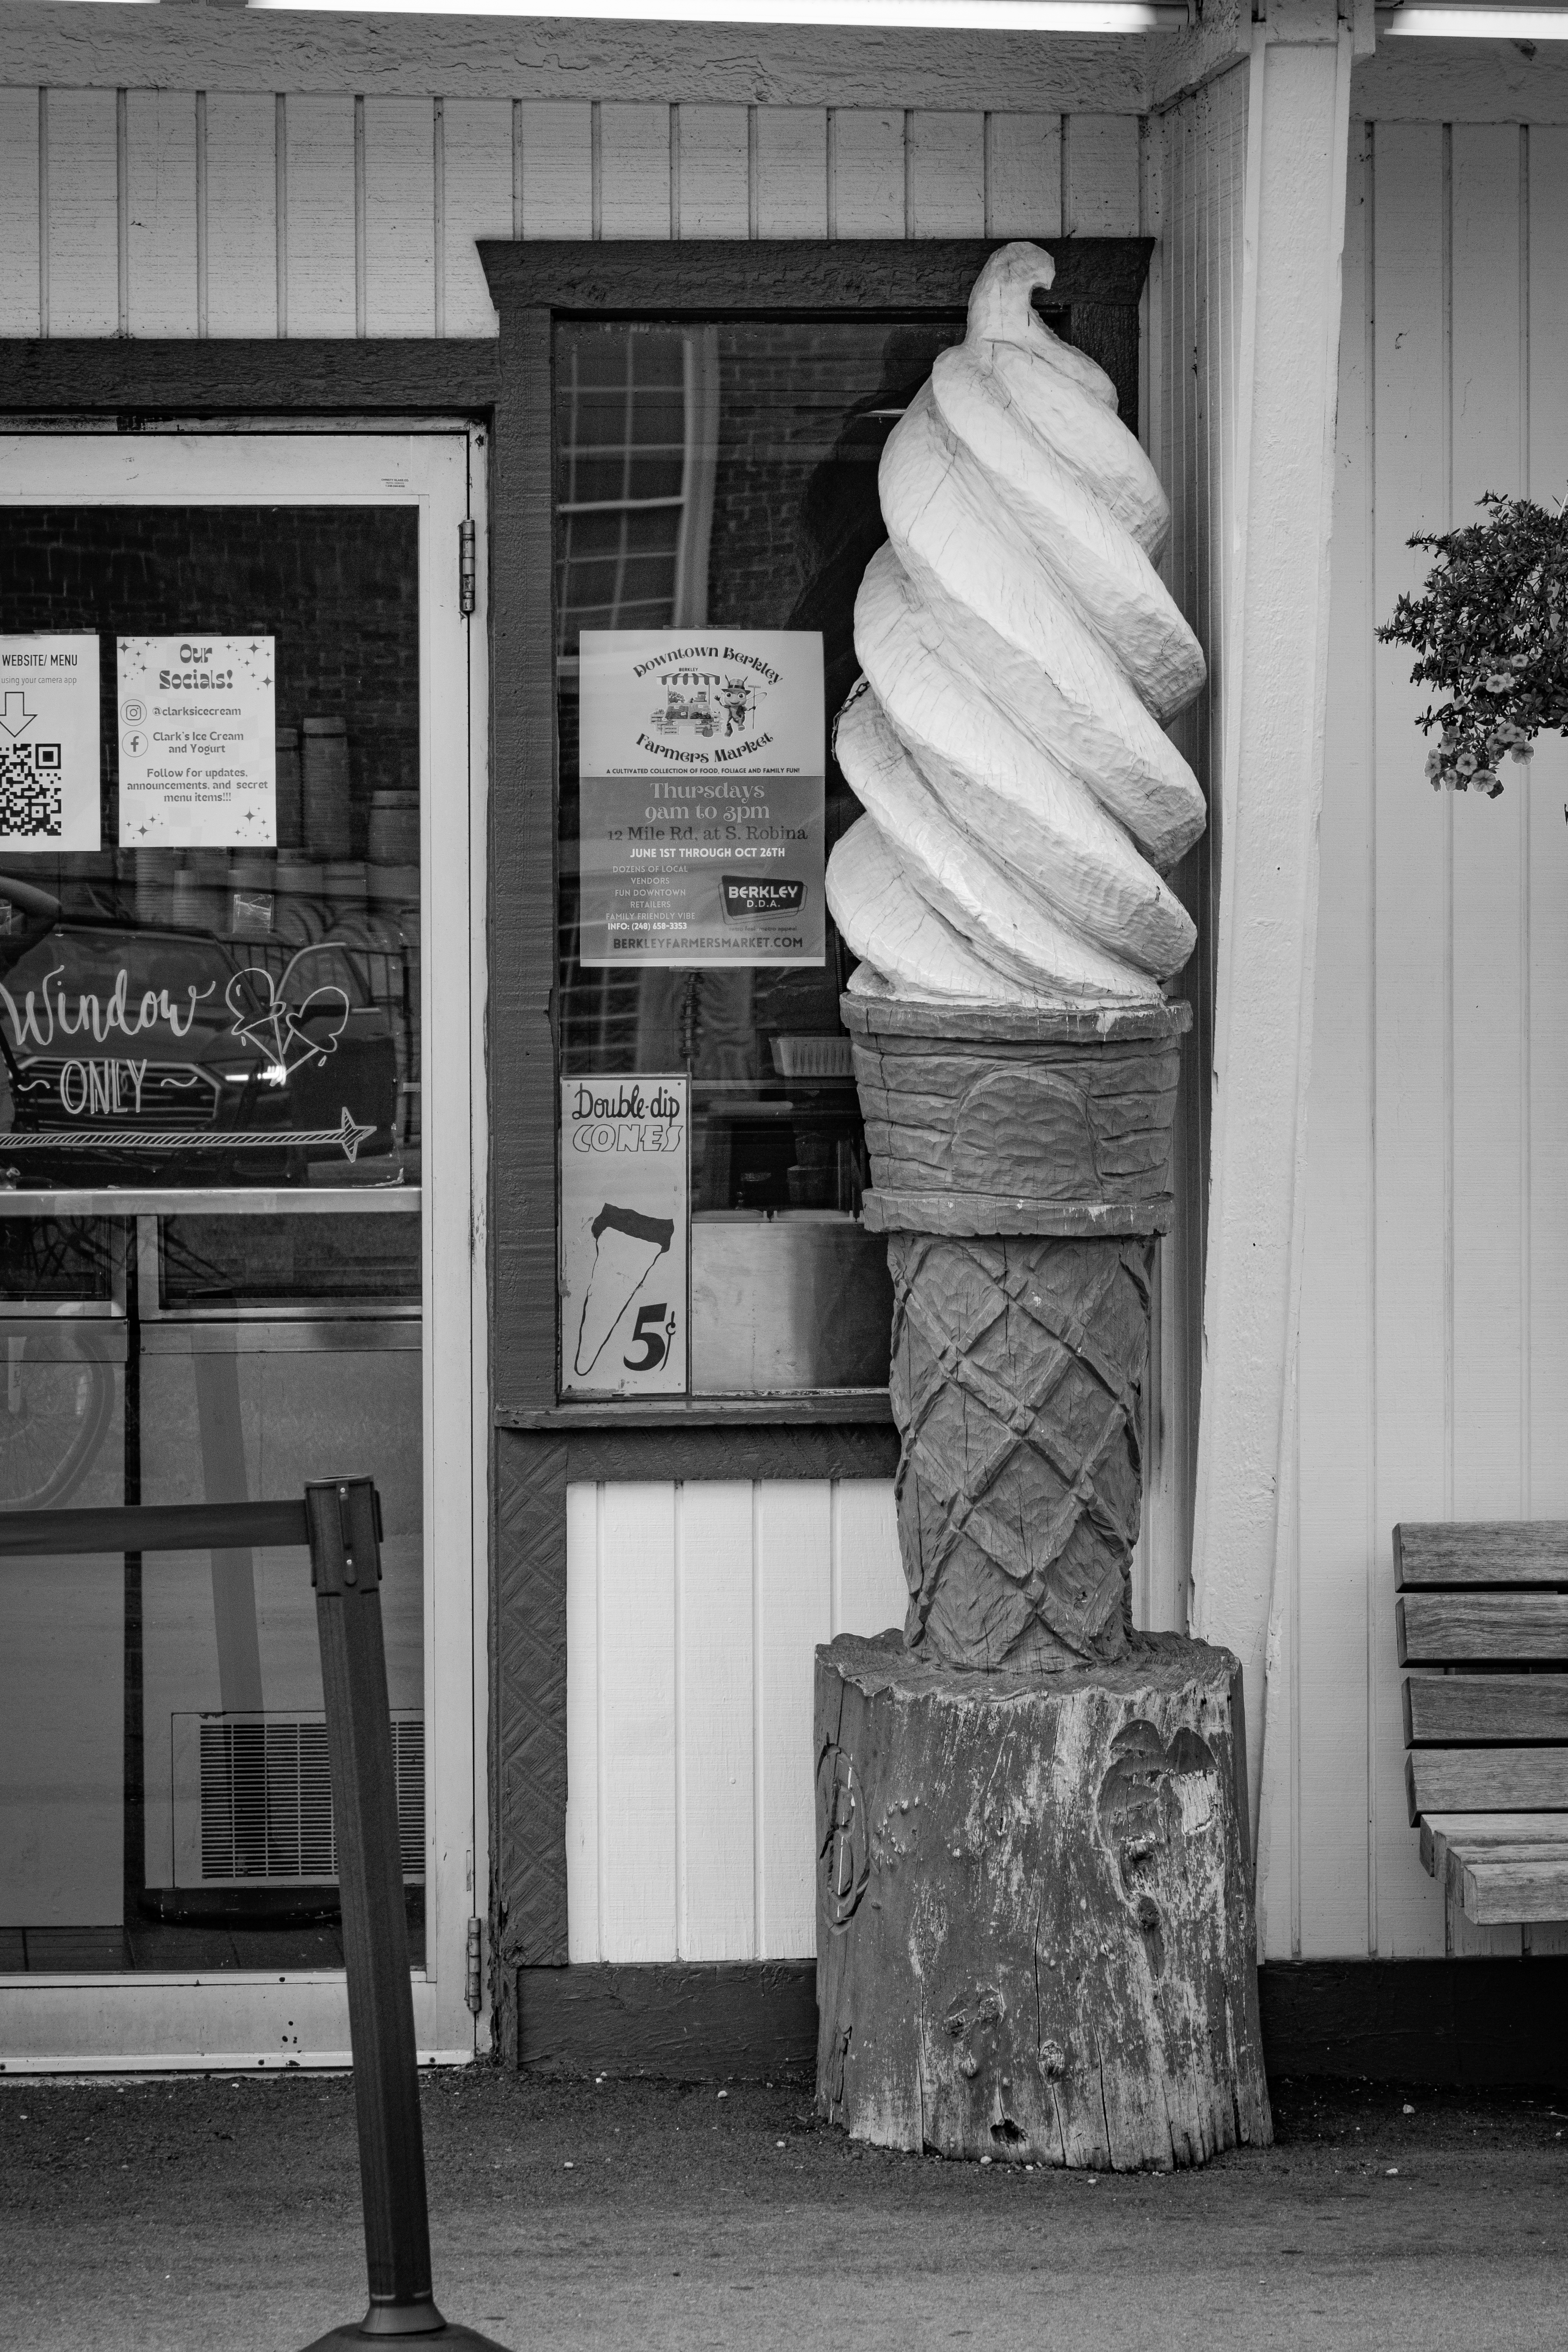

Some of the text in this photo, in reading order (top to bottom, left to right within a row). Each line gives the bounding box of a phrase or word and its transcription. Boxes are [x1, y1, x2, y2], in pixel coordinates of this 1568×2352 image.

[180, 644, 212, 663] Our
[2, 654, 77, 666] WEBSITE/ MENU
[633, 647, 783, 685] Downtown Berkley
[1, 676, 20, 686] using
[21, 677, 36, 686] your
[64, 677, 77, 686] app
[160, 669, 233, 689] Socials!
[152, 706, 241, 716] @clarksicecream
[153, 731, 244, 741] Clark's Ice Cream
[169, 744, 225, 755] and Yogurt
[636, 731, 773, 763] Farmers Market
[147, 768, 248, 779] Follow for updates,
[127, 780, 268, 790] announcements, and secret
[195, 792, 231, 802] items!!!
[650, 782, 765, 804] Thursdays
[645, 804, 769, 824] 9am to 3pm
[608, 831, 622, 841] 12
[627, 826, 665, 841] Mile
[703, 827, 721, 840] at
[726, 826, 741, 840] S.
[746, 826, 808, 840] Robina
[630, 848, 785, 858] JUNE 1ST THROUGH OCT 26TH
[729, 886, 798, 898] BERKLEY
[632, 922, 651, 931] (248)
[613, 937, 803, 949] BERKLEYFARMERSMARKET.COM
[0, 965, 216, 1045] Window
[60, 1059, 147, 1114] ONLY
[573, 1123, 684, 1152] CONES
[623, 1302, 677, 1371] 5¢
